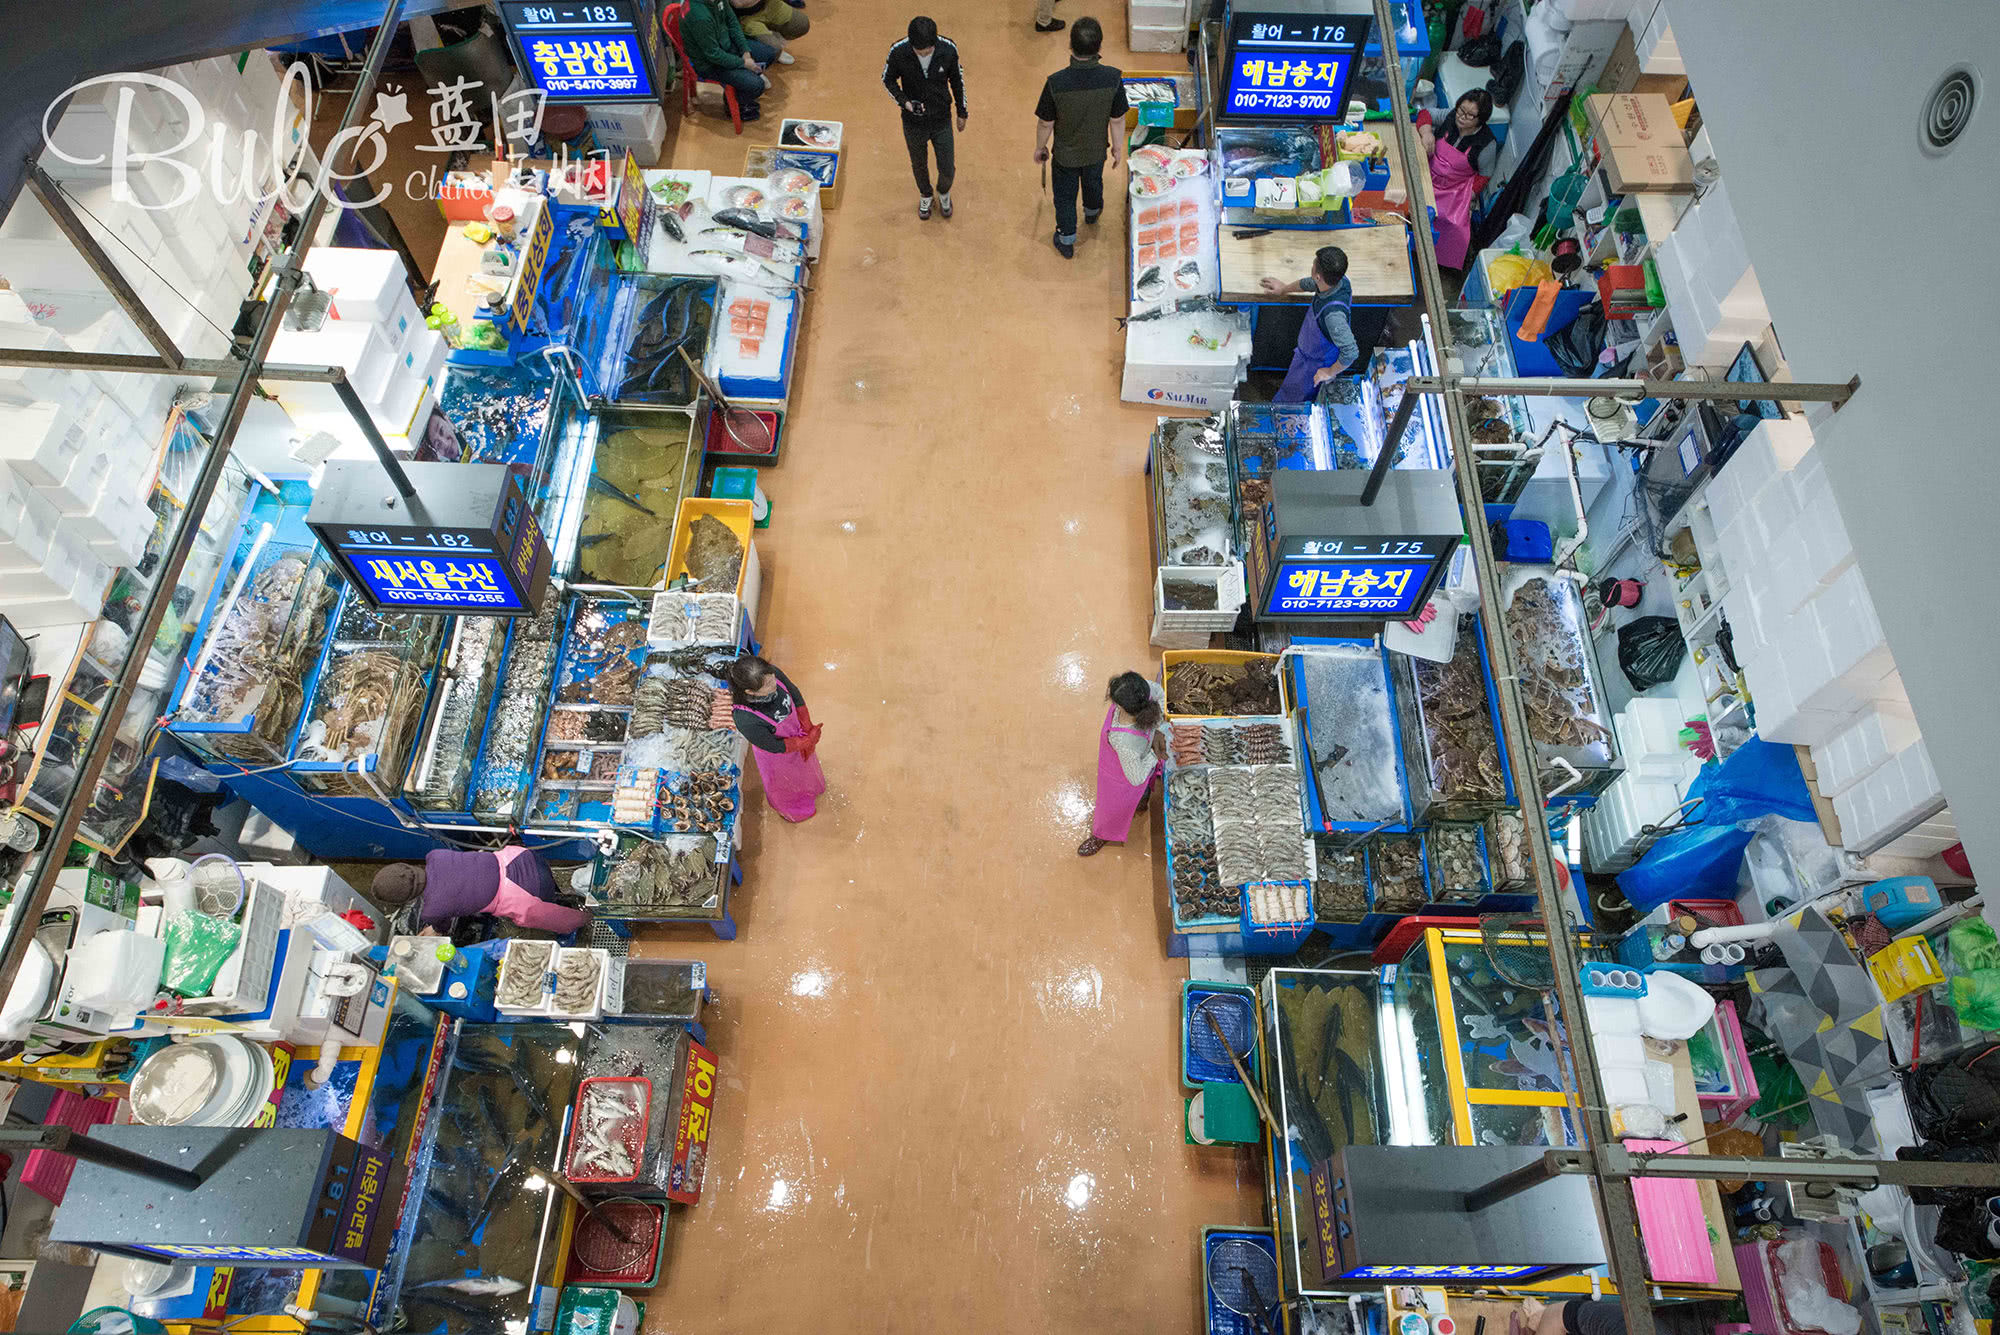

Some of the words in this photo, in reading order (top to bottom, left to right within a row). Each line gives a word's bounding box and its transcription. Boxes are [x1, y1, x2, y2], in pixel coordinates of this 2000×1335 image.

[523, 7, 557, 23] 활어
[582, 6, 618, 22] 183
[1251, 23, 1283, 40] 활어
[1312, 25, 1347, 41] 176
[532, 40, 635, 76] 충남상회
[546, 78, 638, 91] 010-5470-3997
[1242, 59, 1339, 88] 해남송지
[1234, 93, 1331, 109] 010-7123-9700
[346, 529, 393, 545] 활어
[426, 533, 473, 547] 182
[516, 514, 540, 577] 새서울수산
[1302, 541, 1343, 554] 활어
[1380, 542, 1424, 554] 175
[368, 559, 498, 591] 새서울수산
[1289, 569, 1412, 597] 해남송지
[388, 591, 505, 603] 010-5341-4255
[1281, 599, 1398, 609] 010-7123-9700
[687, 1057, 717, 1144] 전어
[323, 1165, 349, 1218] 181
[344, 1157, 383, 1248] 벌교아줌마
